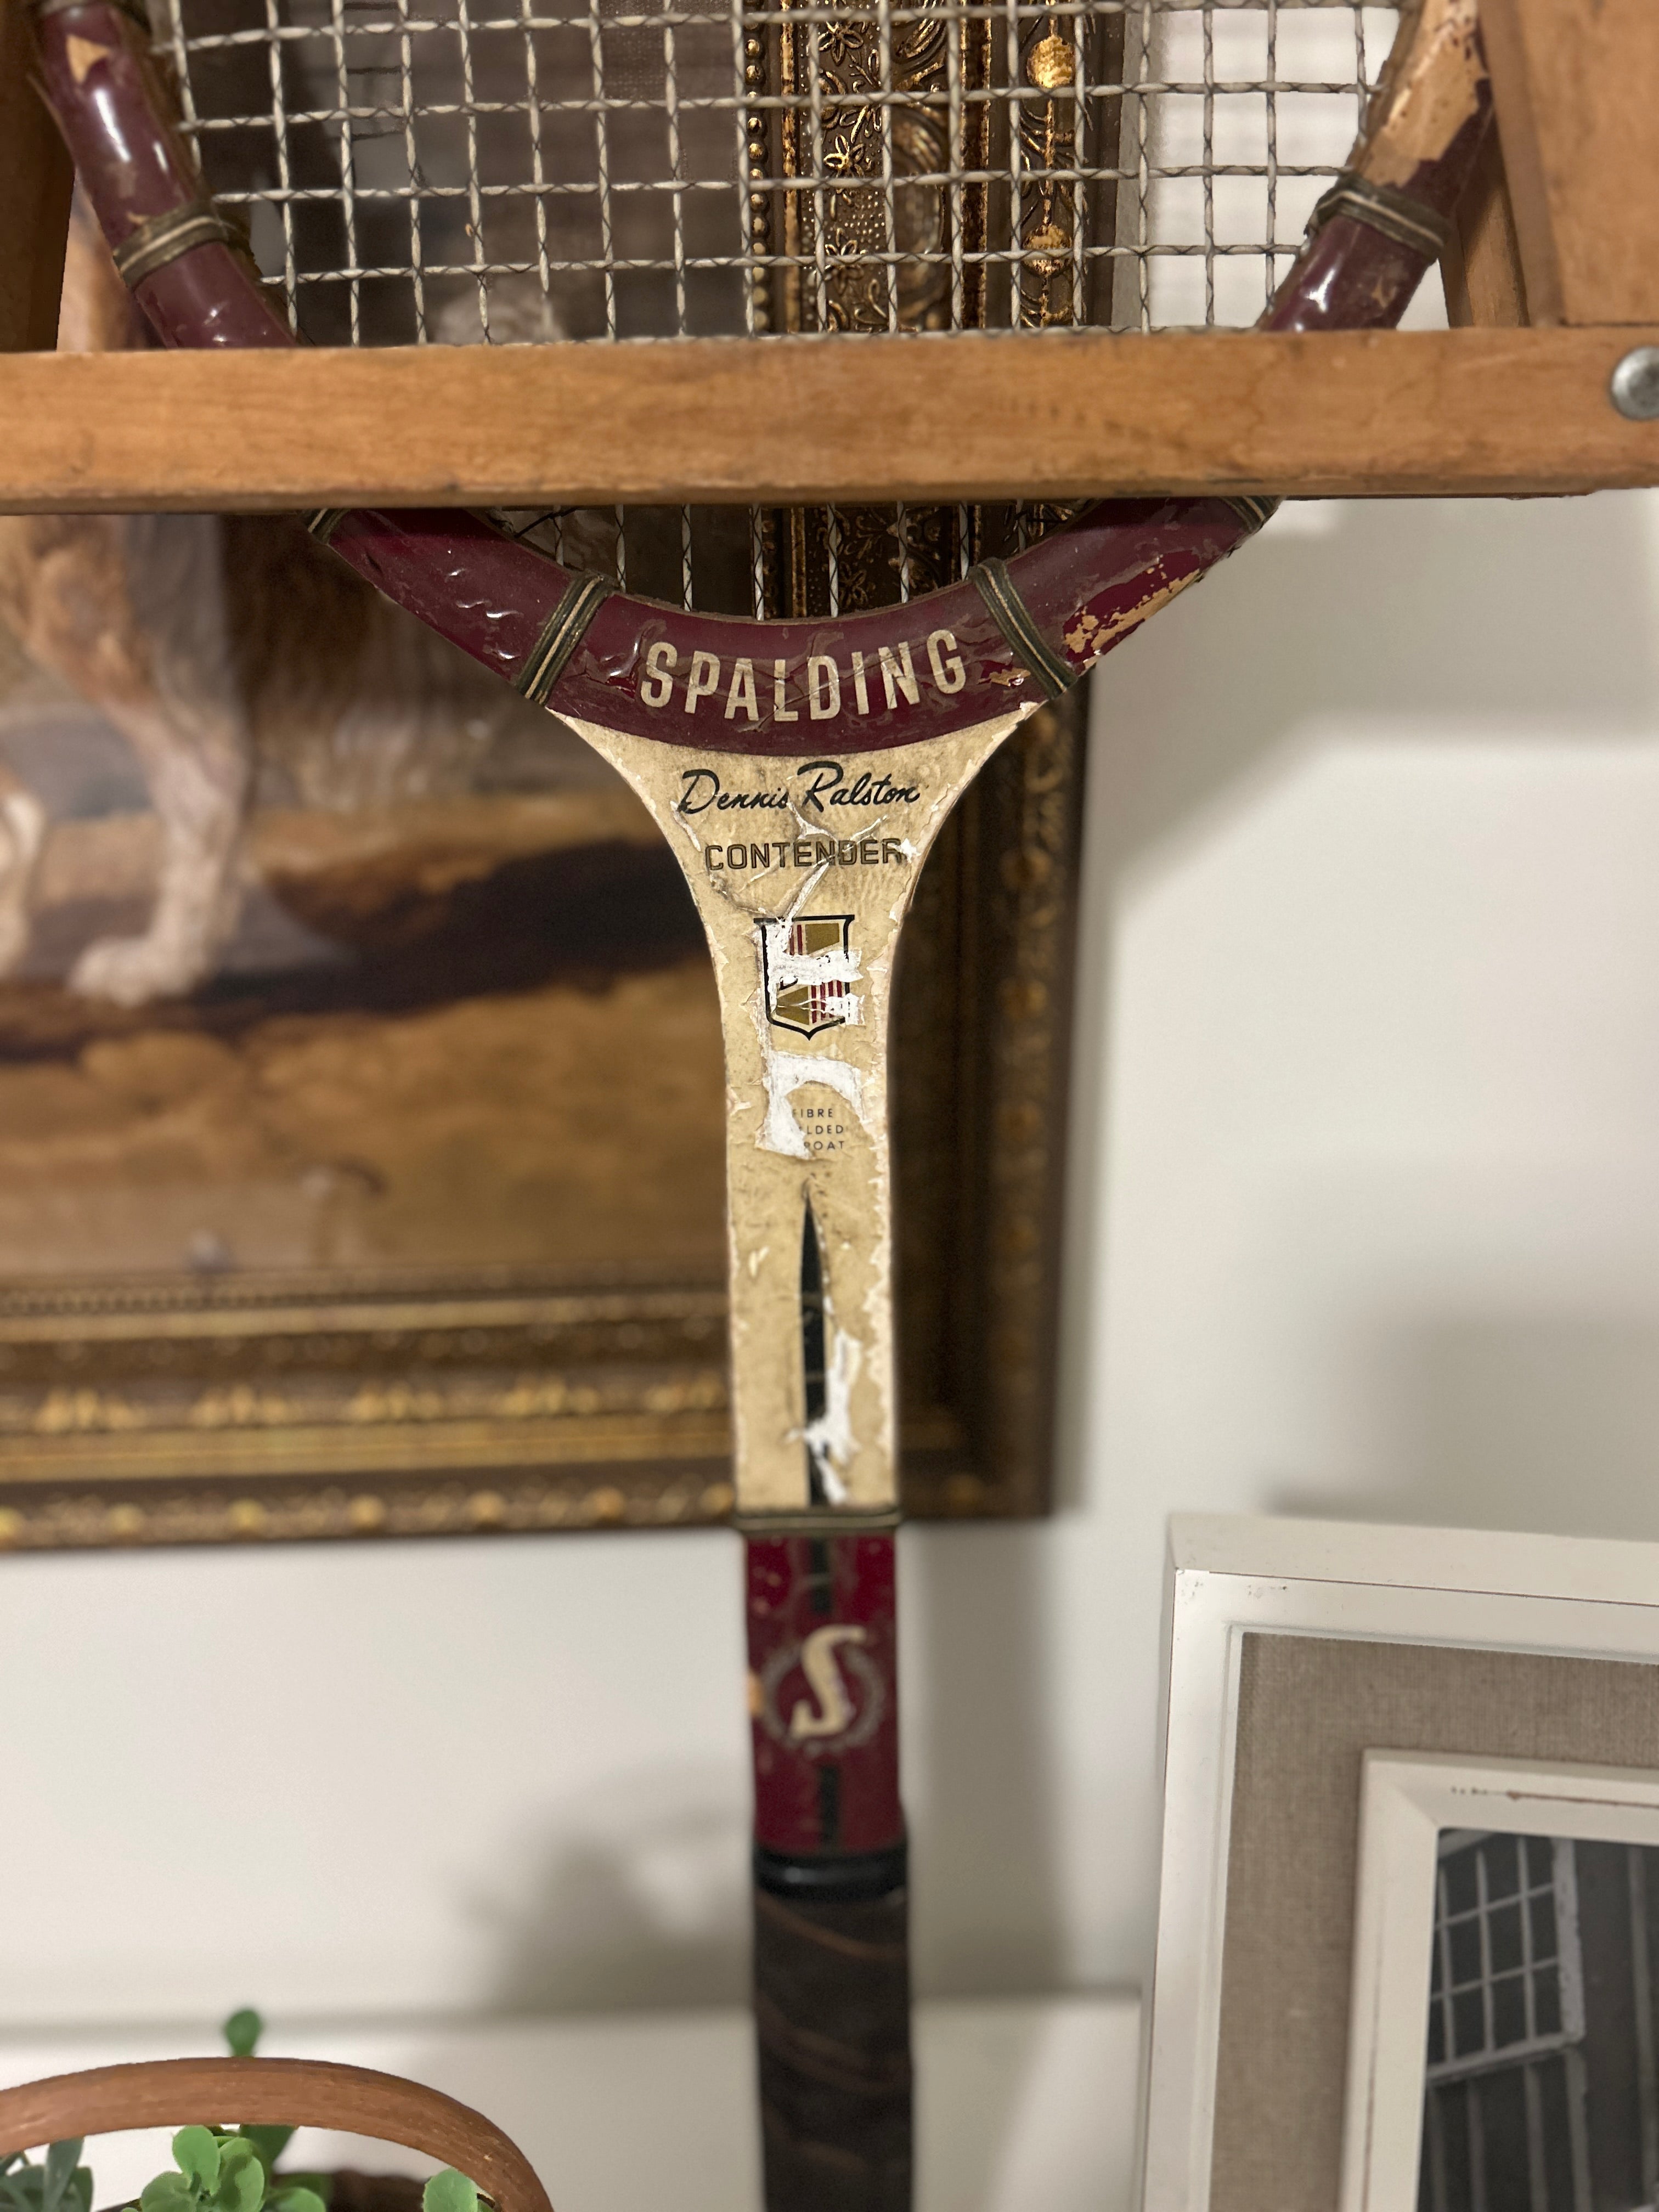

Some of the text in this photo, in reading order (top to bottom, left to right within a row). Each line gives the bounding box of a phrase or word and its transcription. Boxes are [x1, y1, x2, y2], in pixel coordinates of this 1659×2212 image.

[640, 629, 966, 721] SPALDING
[679, 761, 921, 814] Dennis Ralston
[705, 838, 904, 871] CONTENDER
[792, 1108, 833, 1118] FIBRE
